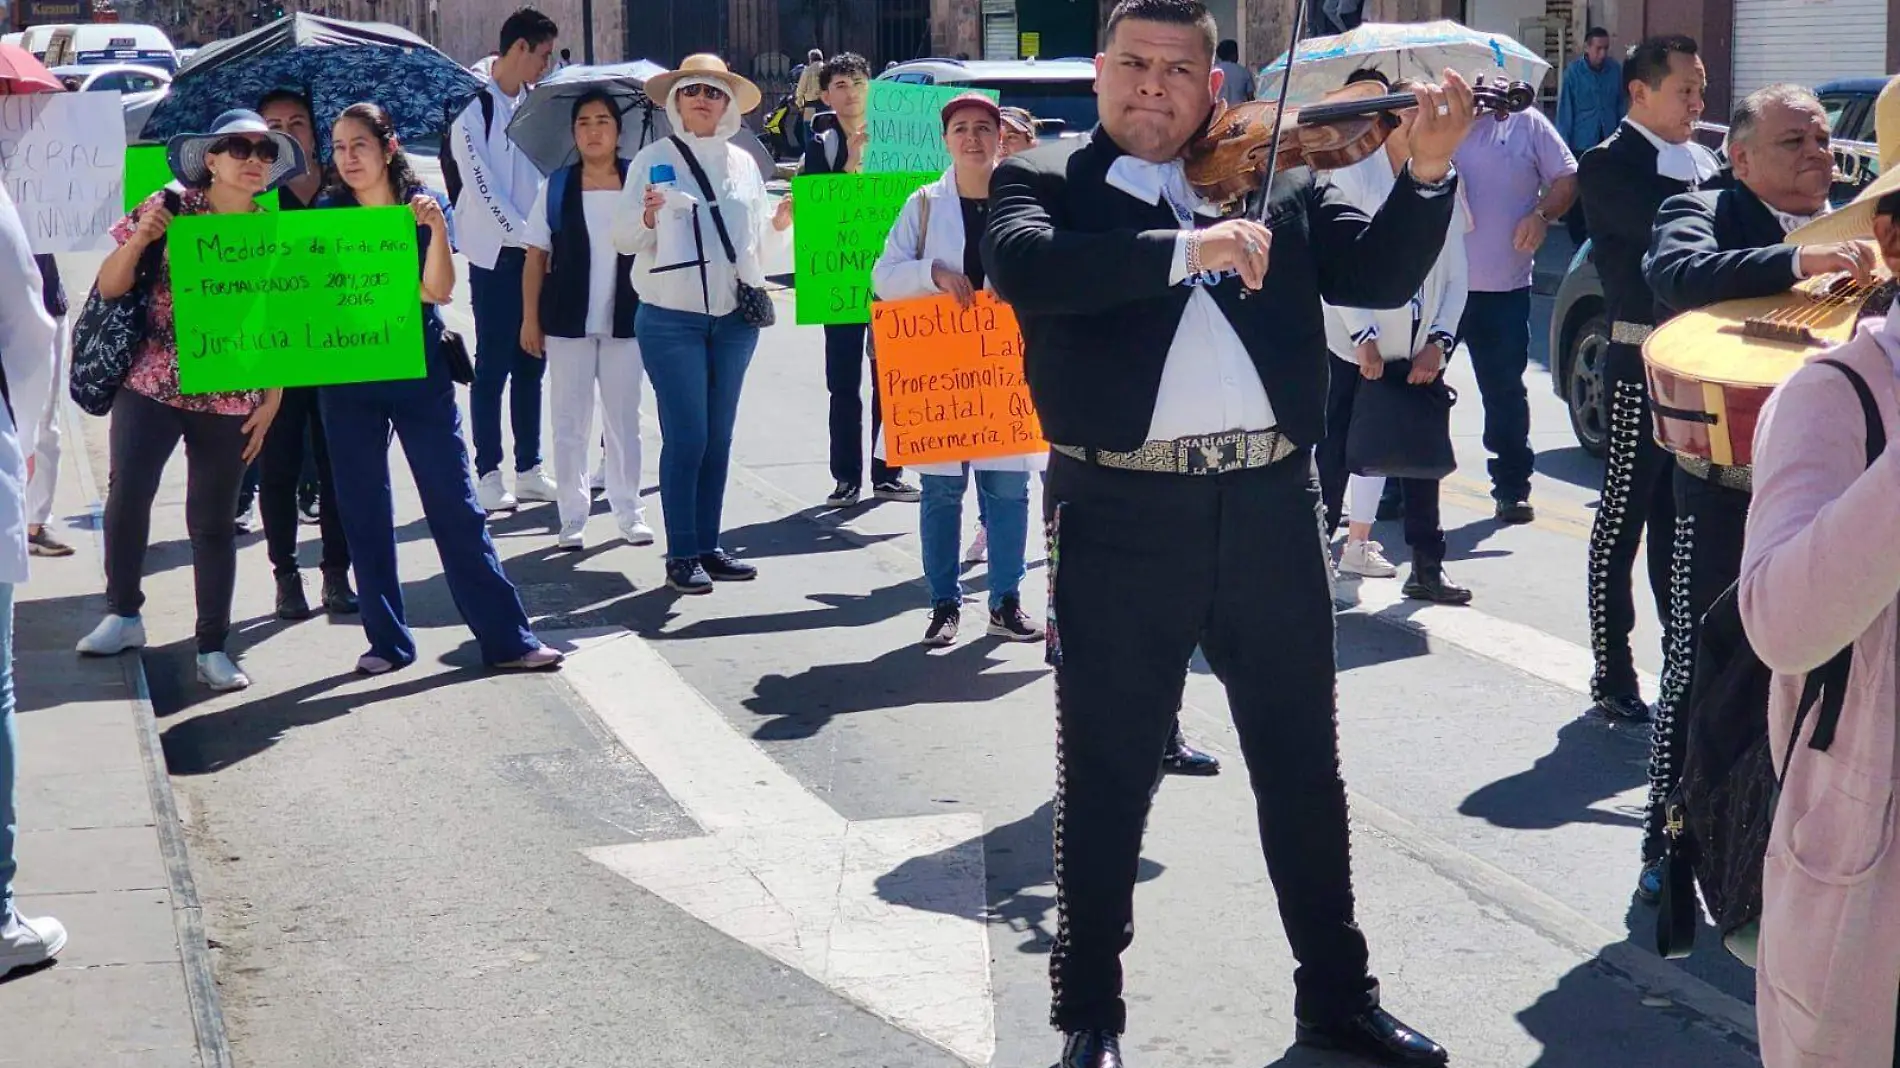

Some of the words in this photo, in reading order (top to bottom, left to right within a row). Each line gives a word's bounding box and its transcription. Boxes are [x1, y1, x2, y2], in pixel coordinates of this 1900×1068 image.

[872, 88, 941, 116] COSTA
[473, 164, 492, 203] YORK
[490, 205, 514, 233] NEW
[836, 228, 859, 247] NO
[201, 274, 311, 297] FORMALIZADOS
[336, 291, 376, 307] 2016
[1179, 432, 1246, 449] MARIACHI
[1193, 466, 1208, 476] LA
